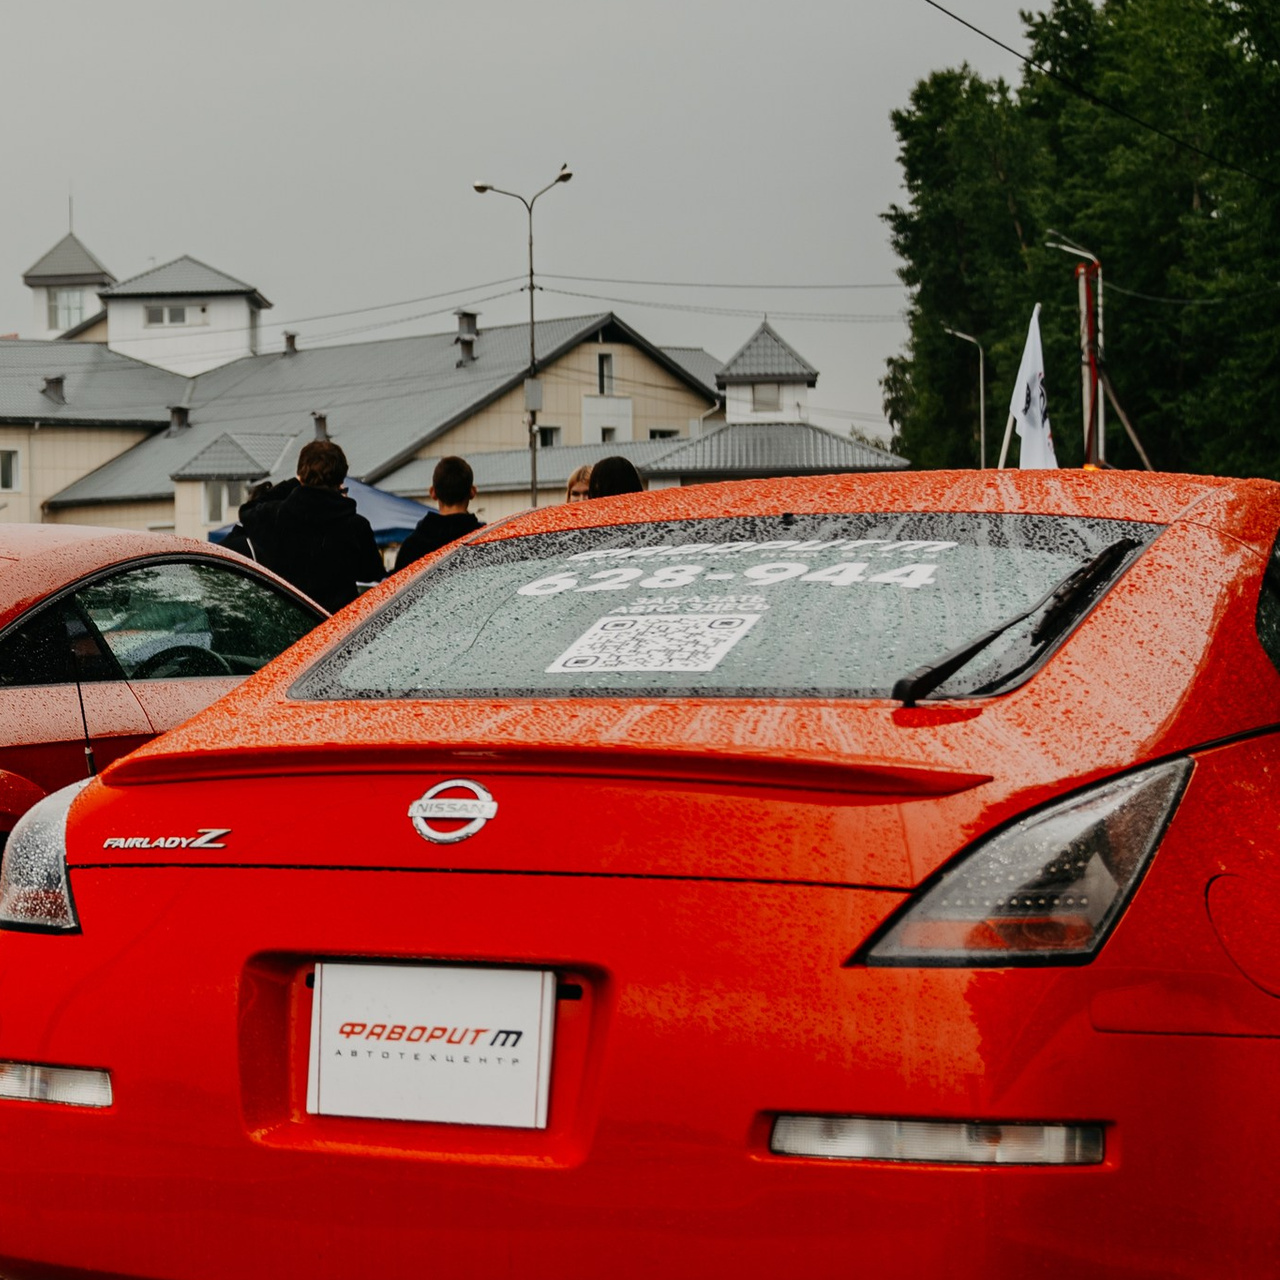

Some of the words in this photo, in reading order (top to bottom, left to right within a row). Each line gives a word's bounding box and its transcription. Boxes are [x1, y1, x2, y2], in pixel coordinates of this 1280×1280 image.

[517, 561, 939, 596] 628-944
[630, 594, 767, 606] ЗАКАЗАТЬ
[608, 604, 680, 615] АВТО
[684, 602, 771, 614] ЗДЕСЬ
[416, 802, 485, 815] NISSAN
[339, 1022, 490, 1046] ФАВОРИТ
[335, 1049, 520, 1066] АВТОТЕХЦЕНТР
